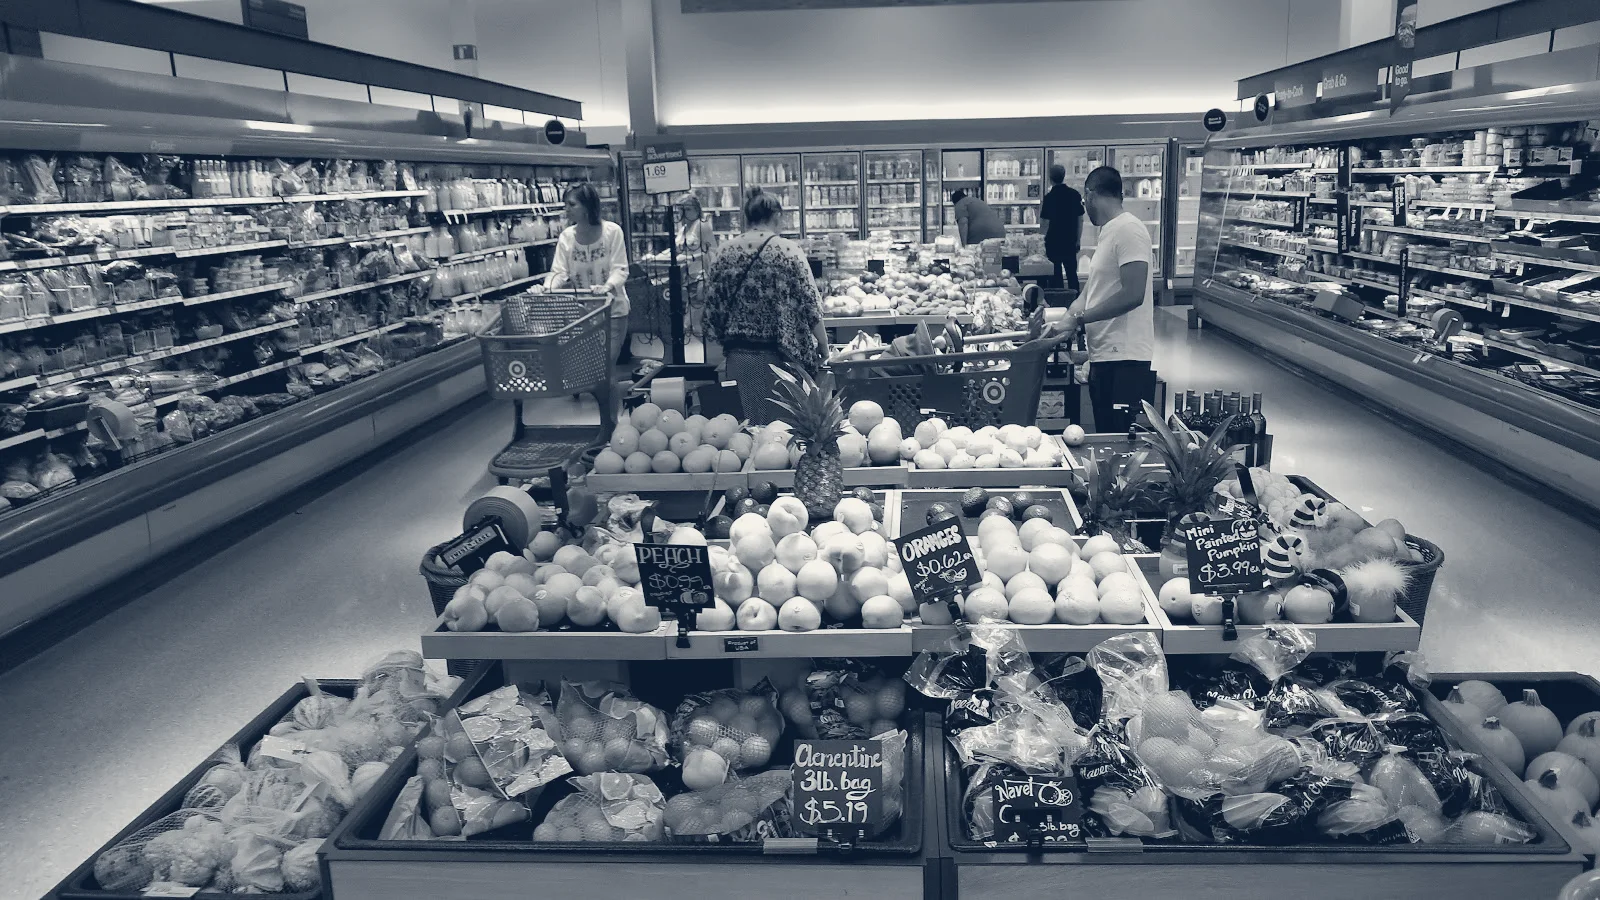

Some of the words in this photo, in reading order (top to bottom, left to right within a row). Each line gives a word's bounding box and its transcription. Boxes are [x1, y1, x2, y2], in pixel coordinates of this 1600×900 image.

[1395, 63, 1408, 75] Good
[1323, 77, 1334, 90] Grab
[1335, 75, 1340, 88] &
[1340, 73, 1347, 86] Go
[646, 165, 666, 176] 1.69
[902, 524, 962, 562] ORANGES
[1185, 525, 1214, 540] Mini
[1196, 529, 1240, 550] Painted
[636, 547, 703, 571] PEACH
[1207, 542, 1258, 561] Pumpkin
[795, 744, 882, 768] Clementine
[800, 769, 838, 791] 3lb.
[841, 771, 876, 801] bag
[995, 776, 1034, 802] Navel
[800, 797, 868, 825] $5.19
[1060, 822, 1080, 838] bag
